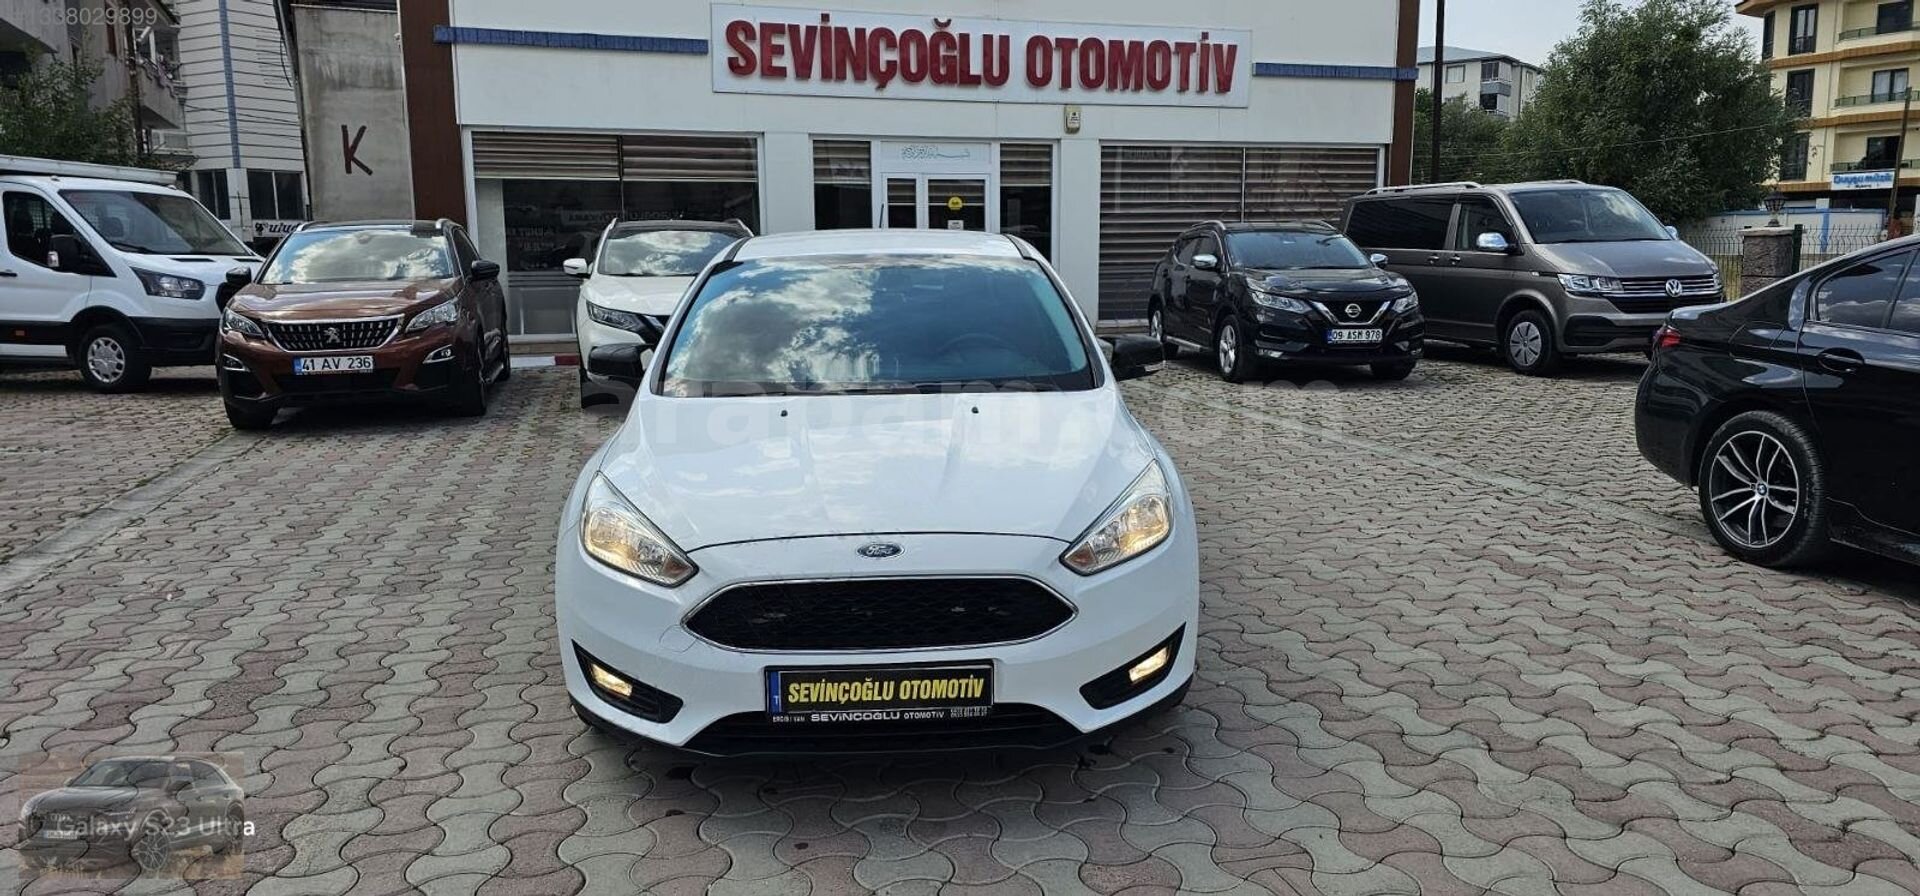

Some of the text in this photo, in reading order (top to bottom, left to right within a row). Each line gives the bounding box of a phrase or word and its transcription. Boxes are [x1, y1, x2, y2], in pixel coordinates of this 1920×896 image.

[725, 13, 1238, 94] SEVİNÇOĞLU OTOMOTİV
[341, 124, 373, 176] K
[1333, 330, 1381, 340] 09 ASM 978
[302, 357, 371, 370] 41 AV 236
[788, 674, 984, 704] SEVİNÇOĞLU OTOMOTİV
